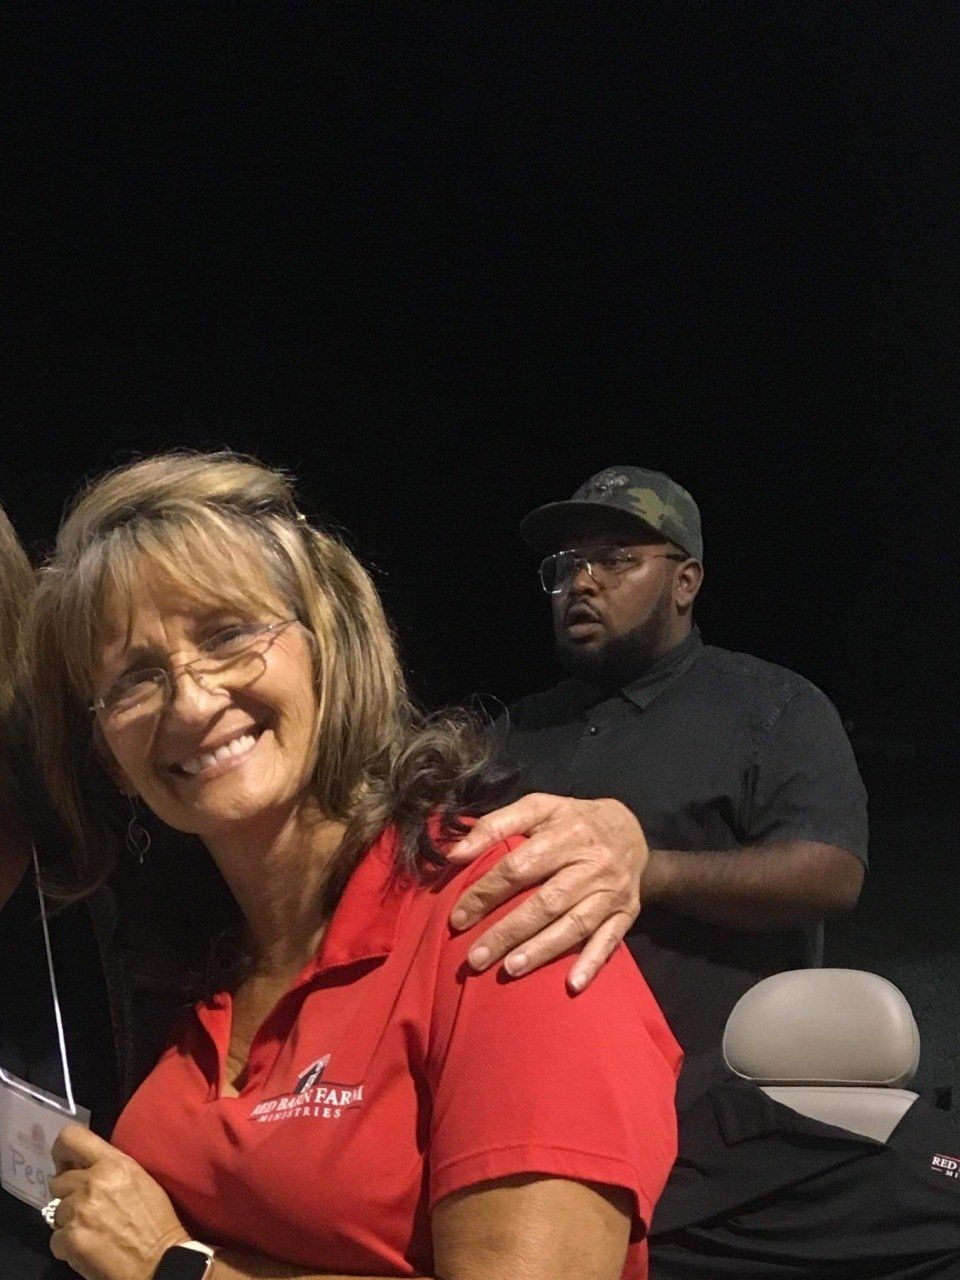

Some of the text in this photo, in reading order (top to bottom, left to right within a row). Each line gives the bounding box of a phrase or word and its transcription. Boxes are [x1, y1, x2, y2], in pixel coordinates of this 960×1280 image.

[314, 1085, 364, 1106] FARM
[257, 1106, 342, 1122] MINISTRIES
[931, 1156, 958, 1170] RED
